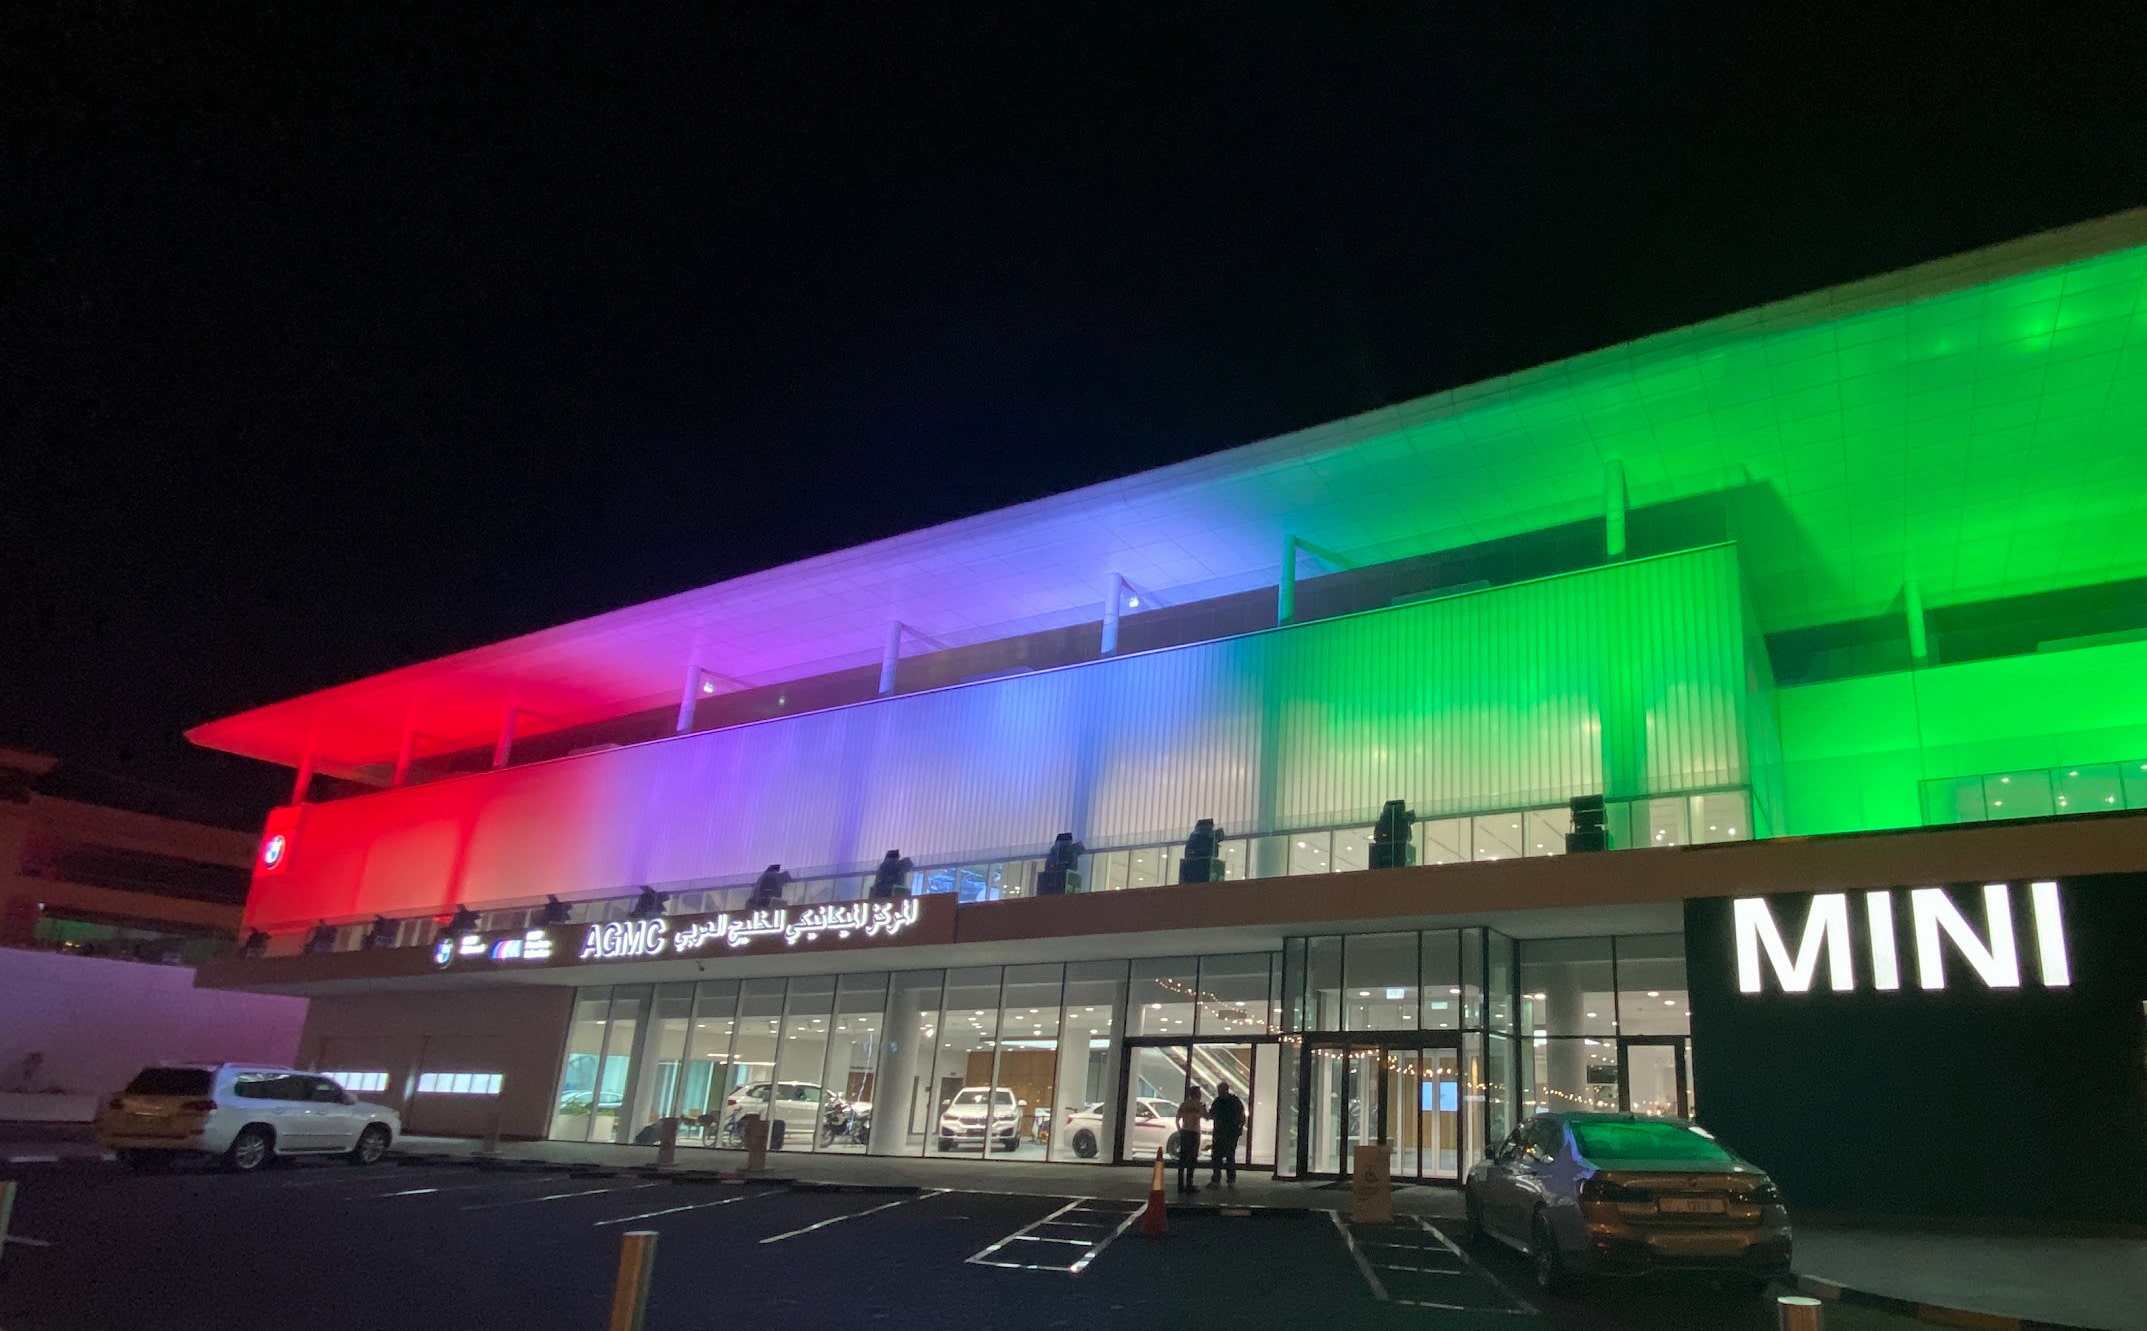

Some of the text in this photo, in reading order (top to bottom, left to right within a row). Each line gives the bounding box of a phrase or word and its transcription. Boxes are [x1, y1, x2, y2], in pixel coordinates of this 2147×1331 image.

[579, 919, 666, 960] AGMC
[674, 898, 918, 952] المركز الميكانيكي للخليج العربي
[1734, 881, 2070, 993] MINI
